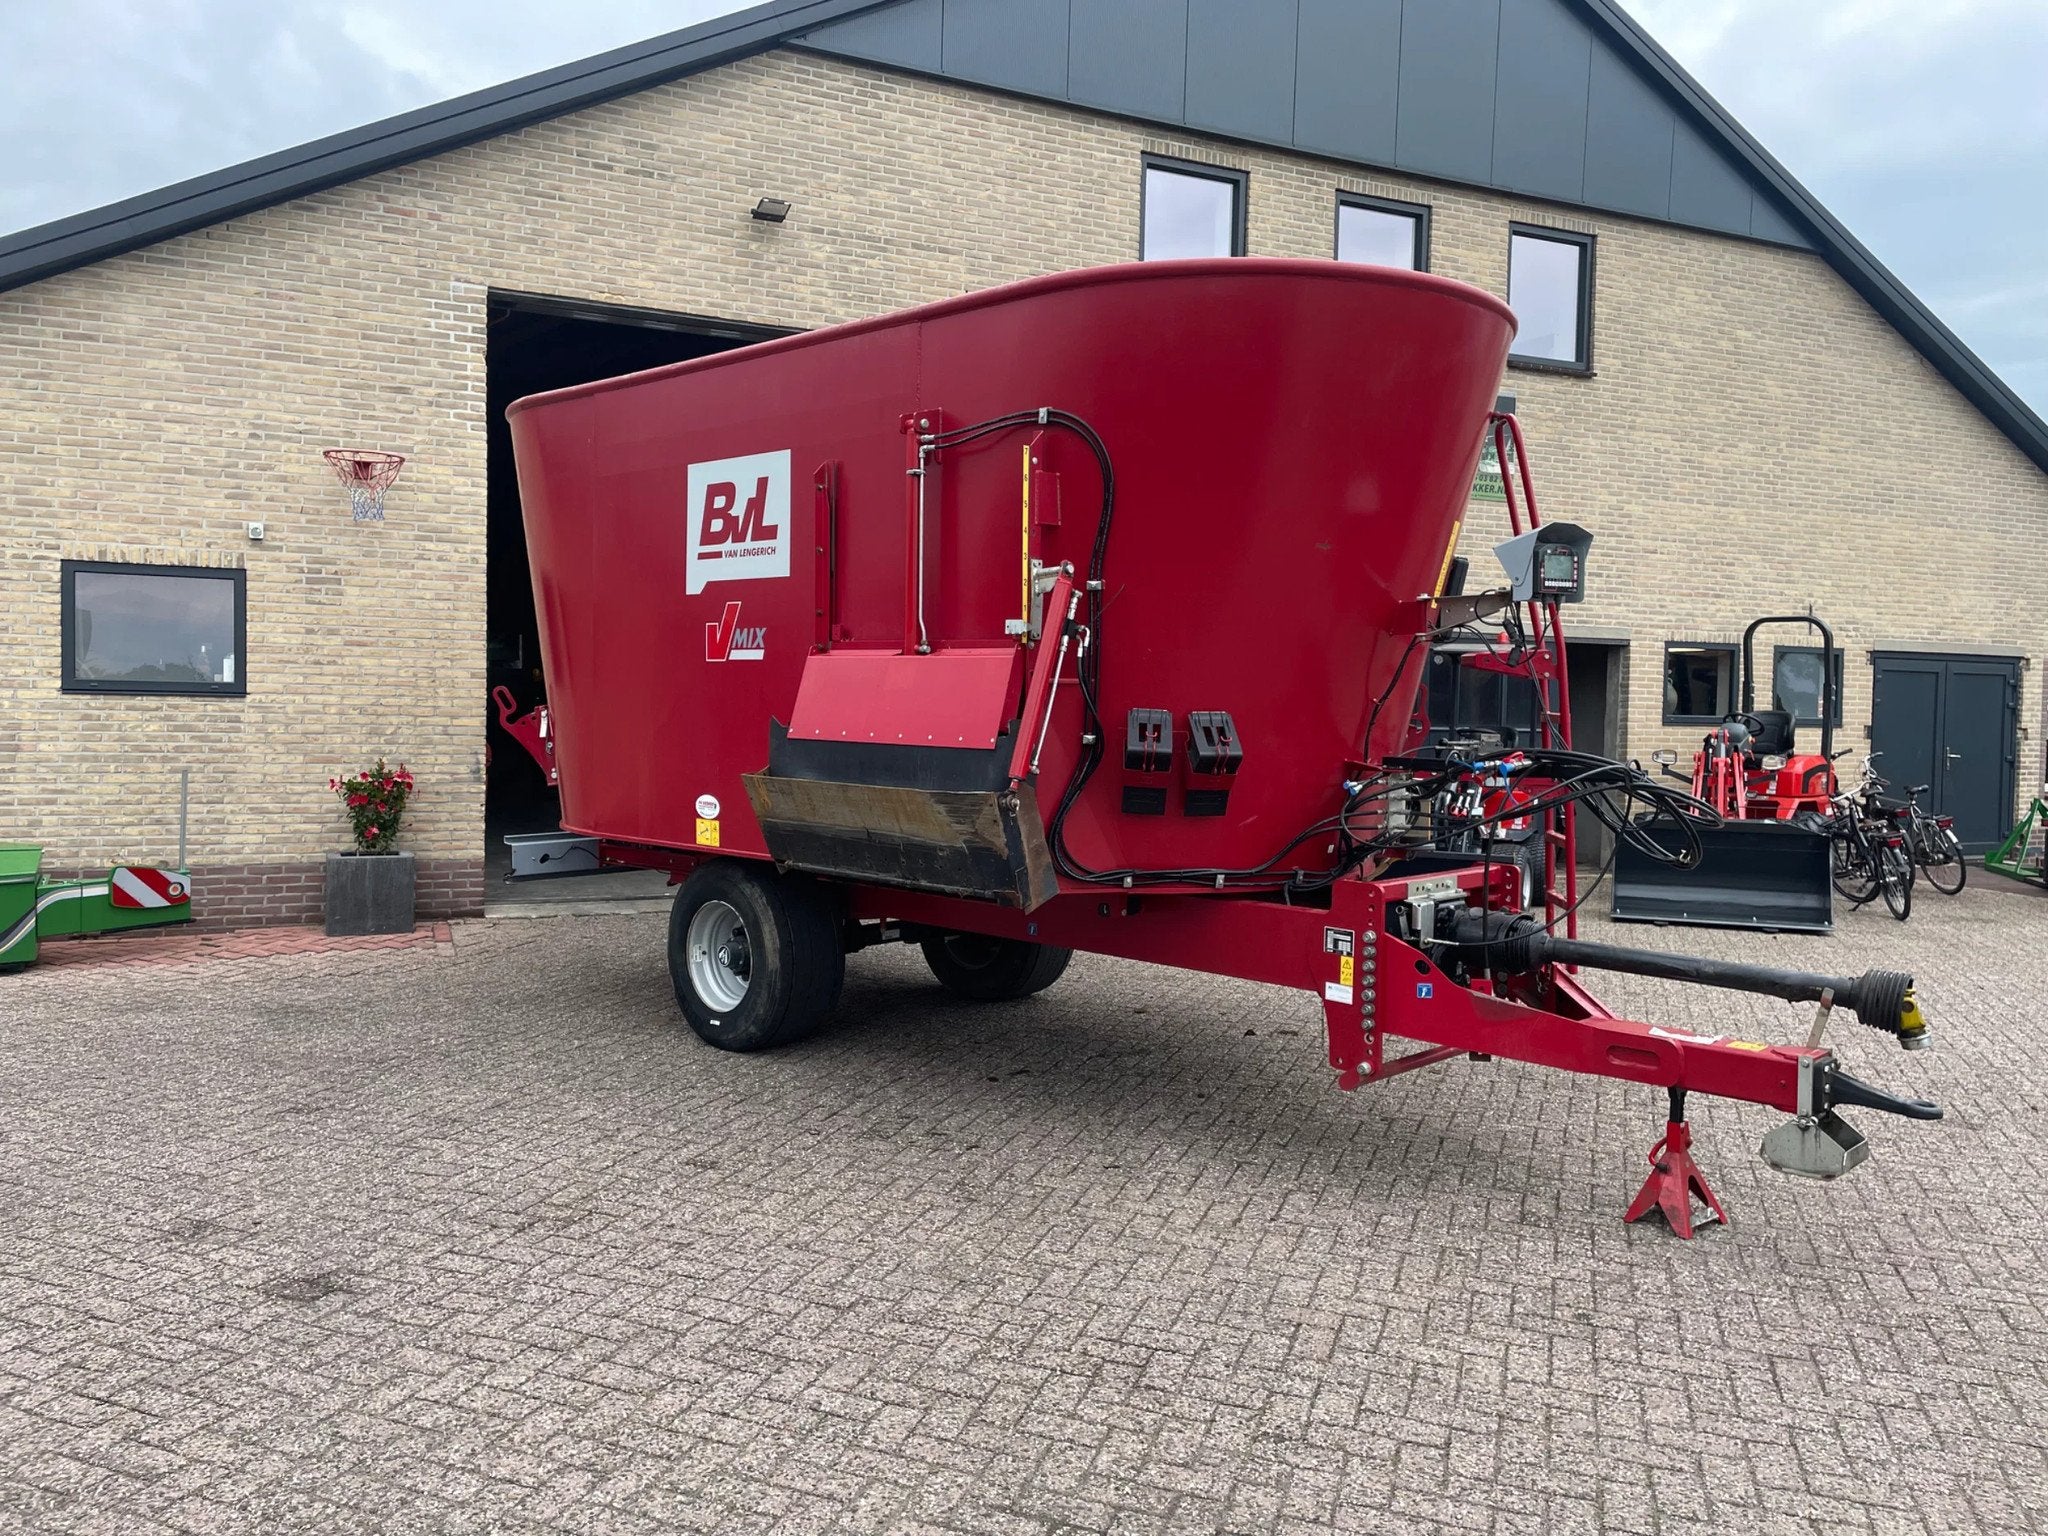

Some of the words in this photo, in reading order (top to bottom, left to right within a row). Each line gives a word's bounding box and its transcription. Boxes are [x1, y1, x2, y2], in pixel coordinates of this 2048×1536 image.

[724, 550, 738, 559] VAN
[739, 546, 776, 558] LENGERICH
[731, 627, 767, 649] MIX
